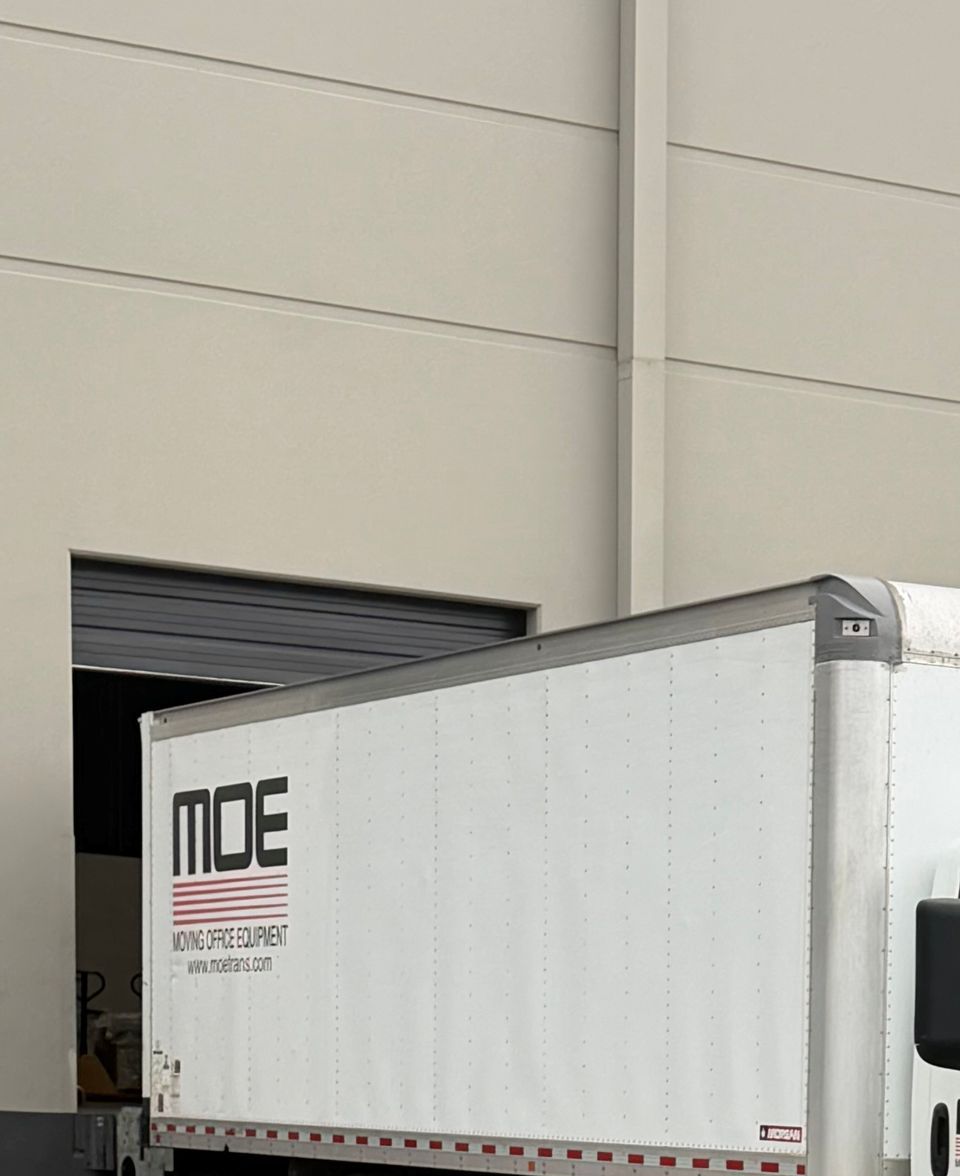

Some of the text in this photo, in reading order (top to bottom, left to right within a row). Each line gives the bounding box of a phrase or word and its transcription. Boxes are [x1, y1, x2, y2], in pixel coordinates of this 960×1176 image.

[173, 776, 288, 876] MOE
[173, 925, 288, 951] MOVING OFFICE EQUIPMENT
[187, 955, 273, 975] www.moetrans.com
